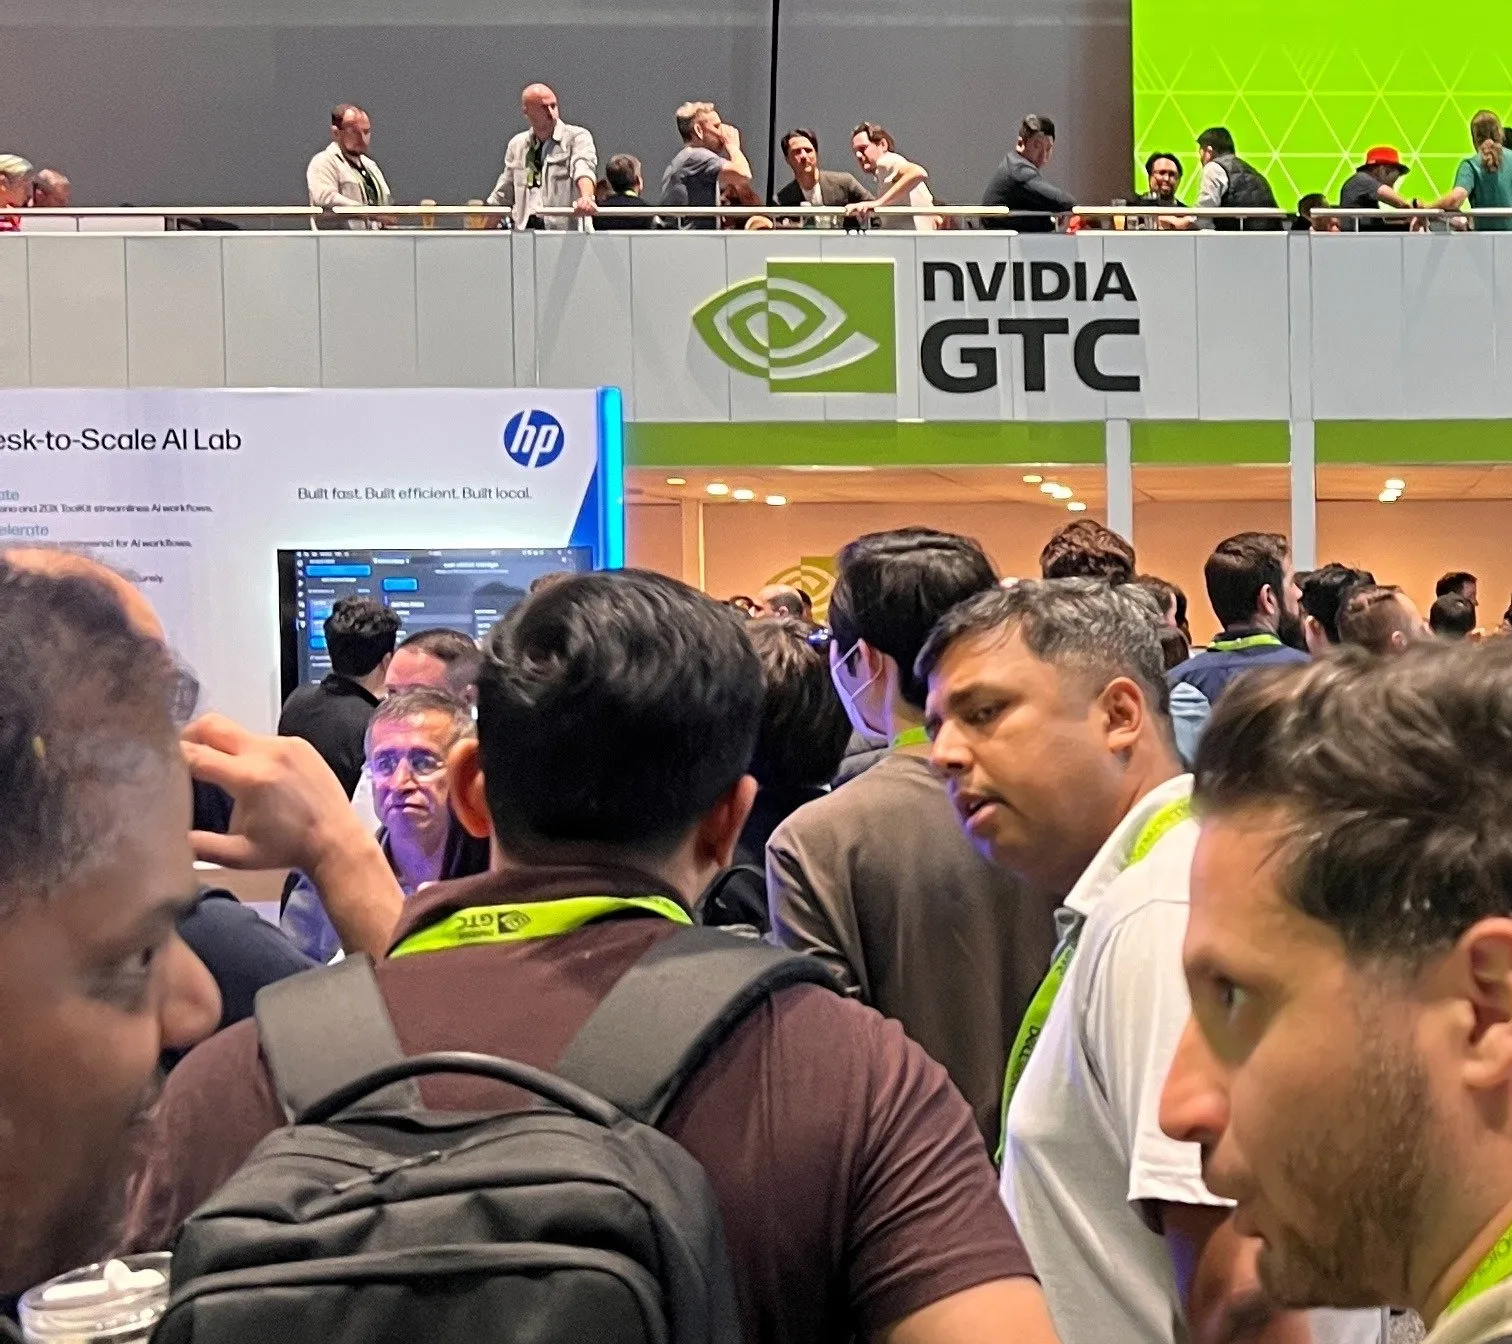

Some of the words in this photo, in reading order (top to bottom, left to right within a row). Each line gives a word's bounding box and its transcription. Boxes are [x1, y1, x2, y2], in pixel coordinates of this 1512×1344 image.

[923, 261, 1137, 301] NVIDIA
[920, 318, 1140, 393] GTC
[162, 429, 187, 450] AI
[195, 429, 242, 450] Lab
[510, 410, 559, 467] hp
[298, 487, 328, 499] Built
[365, 487, 395, 499] Built
[462, 487, 493, 499] Built
